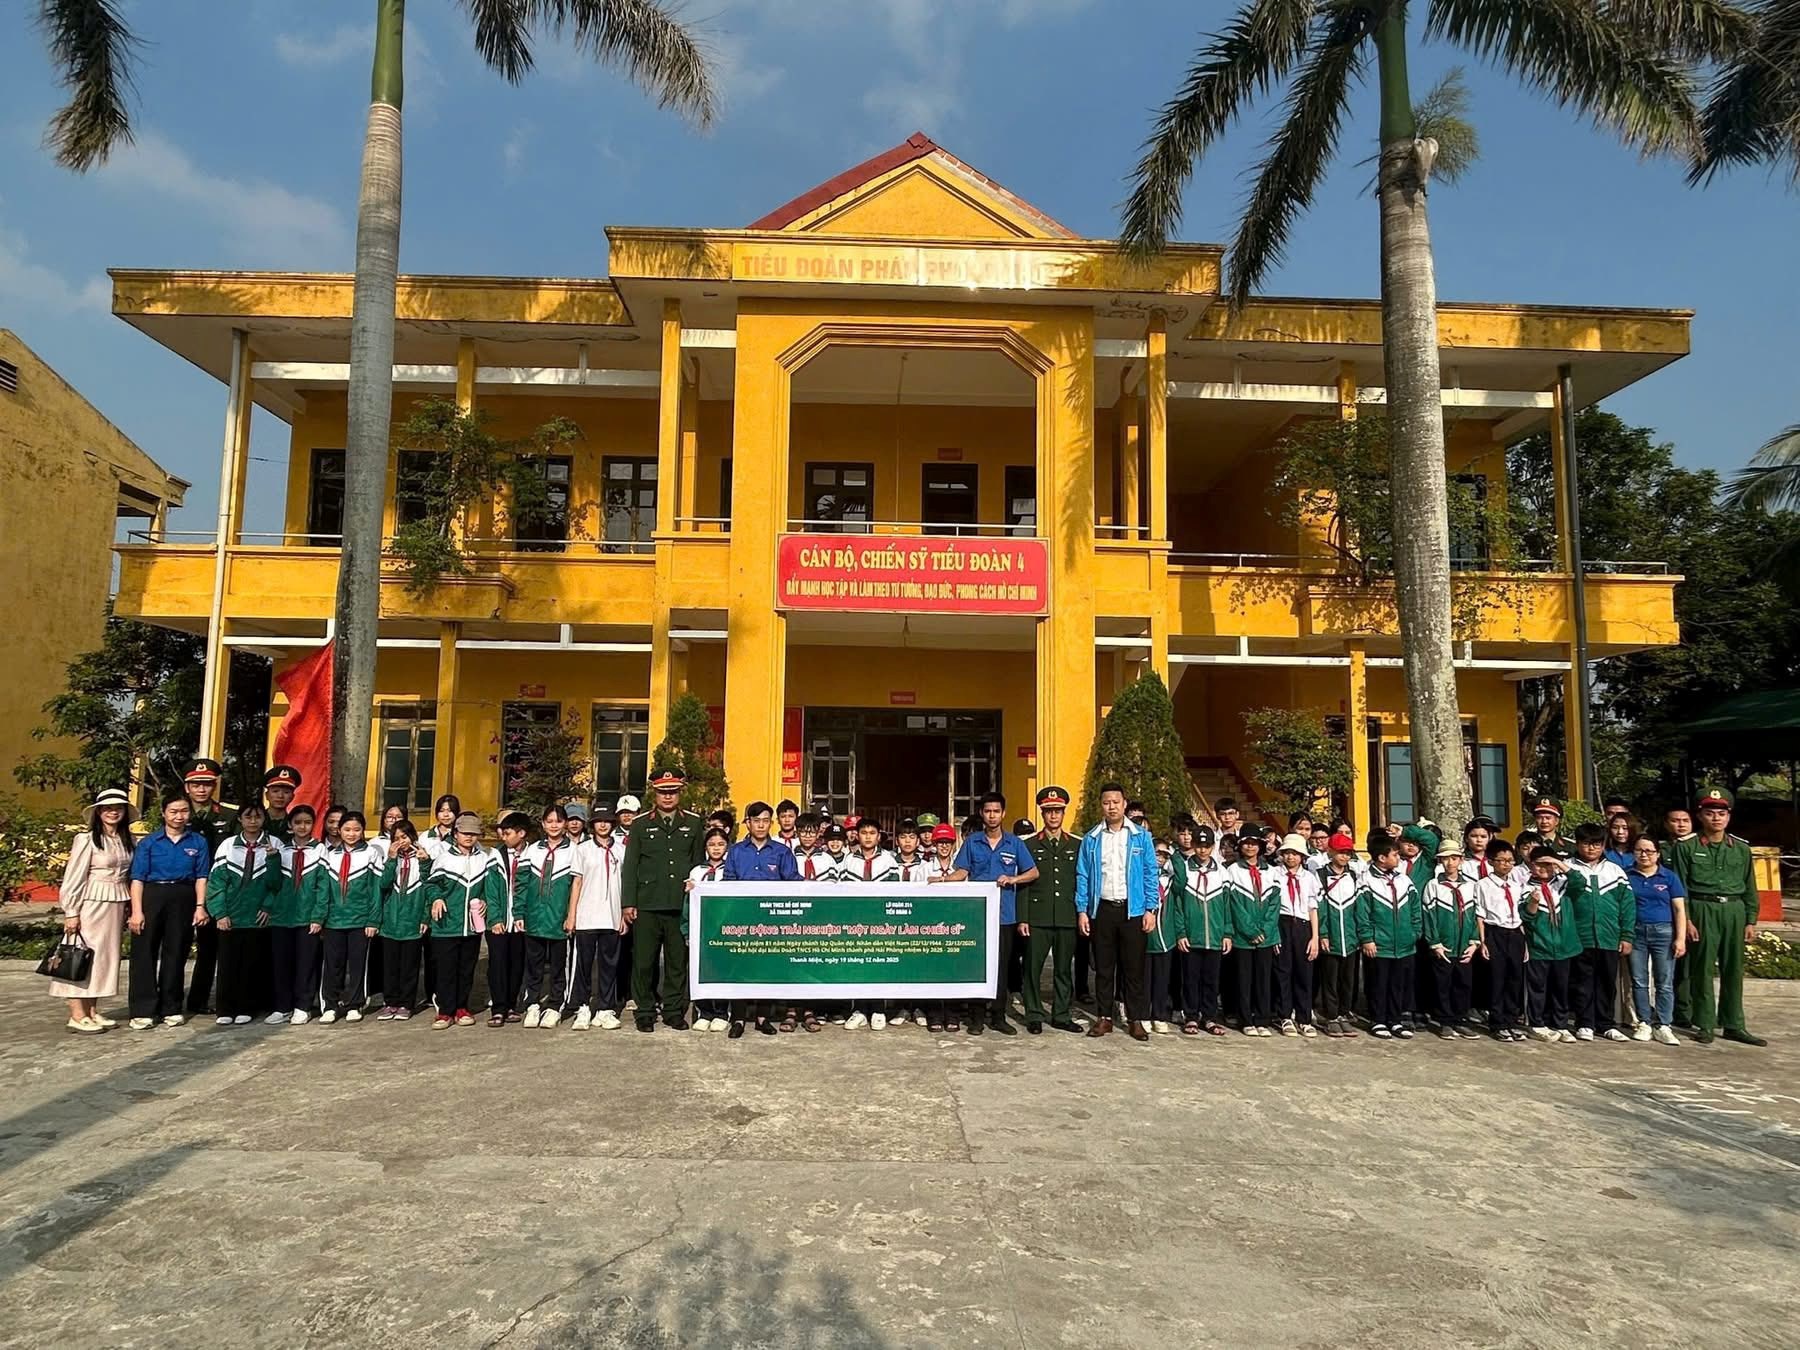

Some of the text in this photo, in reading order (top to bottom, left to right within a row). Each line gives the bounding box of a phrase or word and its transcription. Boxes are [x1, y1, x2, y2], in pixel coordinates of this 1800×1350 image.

[740, 247, 788, 277] TIỂU
[796, 253, 854, 280] ĐOÀN
[800, 542, 1025, 573] CÁN BỘ, CHIẾN SỸ TIỂU ĐOÀN 4
[786, 572, 799, 596] ĐẨY
[800, 579, 820, 598] MẠNH
[821, 580, 834, 598] HỌC
[836, 578, 848, 600] TẬP
[849, 579, 858, 597] VÀ
[859, 579, 873, 597] LÀM
[874, 581, 890, 598] THEO
[924, 582, 938, 600] ĐẠO
[956, 583, 978, 600] PHONG
[979, 581, 997, 600] CÁCH
[998, 579, 1007, 600] HỒ
[1008, 582, 1019, 600] CHÍ
[1020, 585, 1038, 601] MINH
[721, 925, 748, 937] HOẠT
[749, 923, 779, 937] ĐỘNG
[780, 922, 801, 935] TRẢI
[803, 923, 841, 937] NGHIỆM
[869, 922, 897, 935] NGÀY
[898, 922, 919, 935] LÀM
[920, 921, 949, 935] CHIẾN
